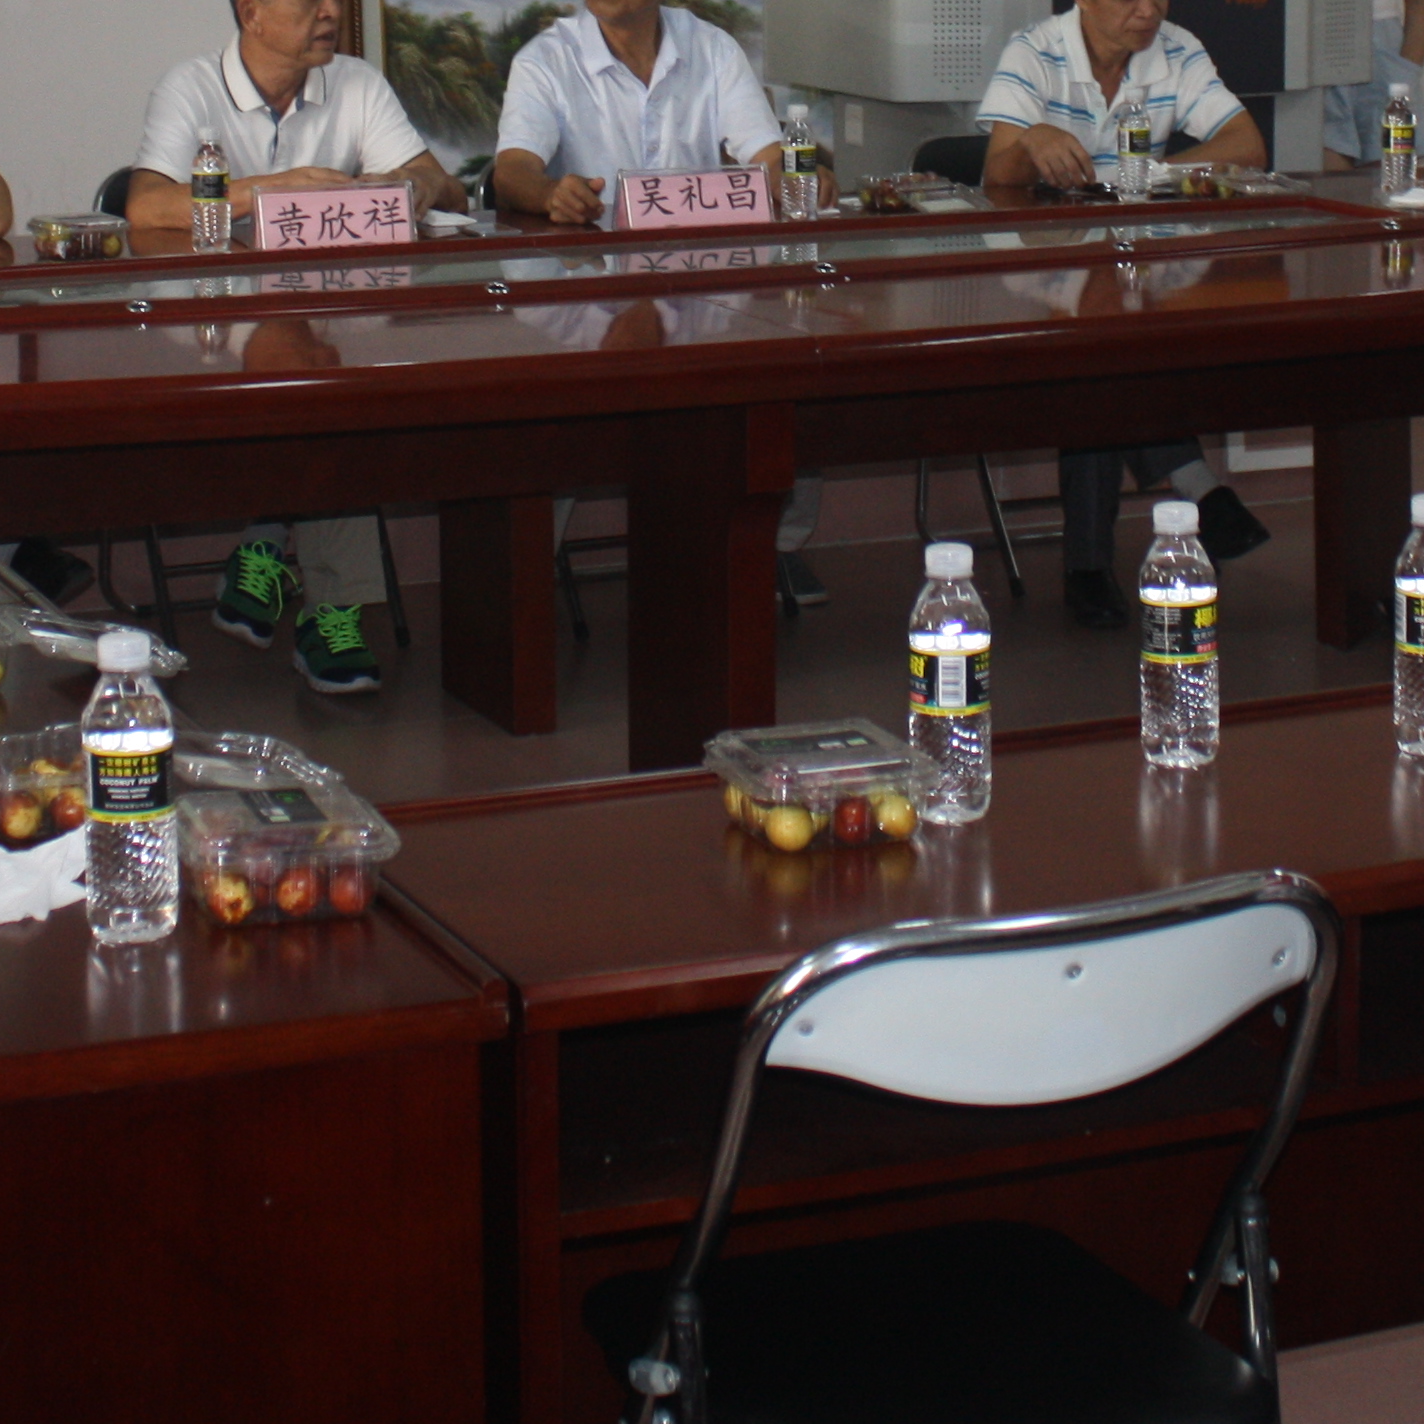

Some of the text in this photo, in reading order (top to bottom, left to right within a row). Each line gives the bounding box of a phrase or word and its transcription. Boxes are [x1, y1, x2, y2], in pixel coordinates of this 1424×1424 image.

[636, 172, 758, 218] 吴礼昌
[269, 195, 409, 249] 黄欣祥
